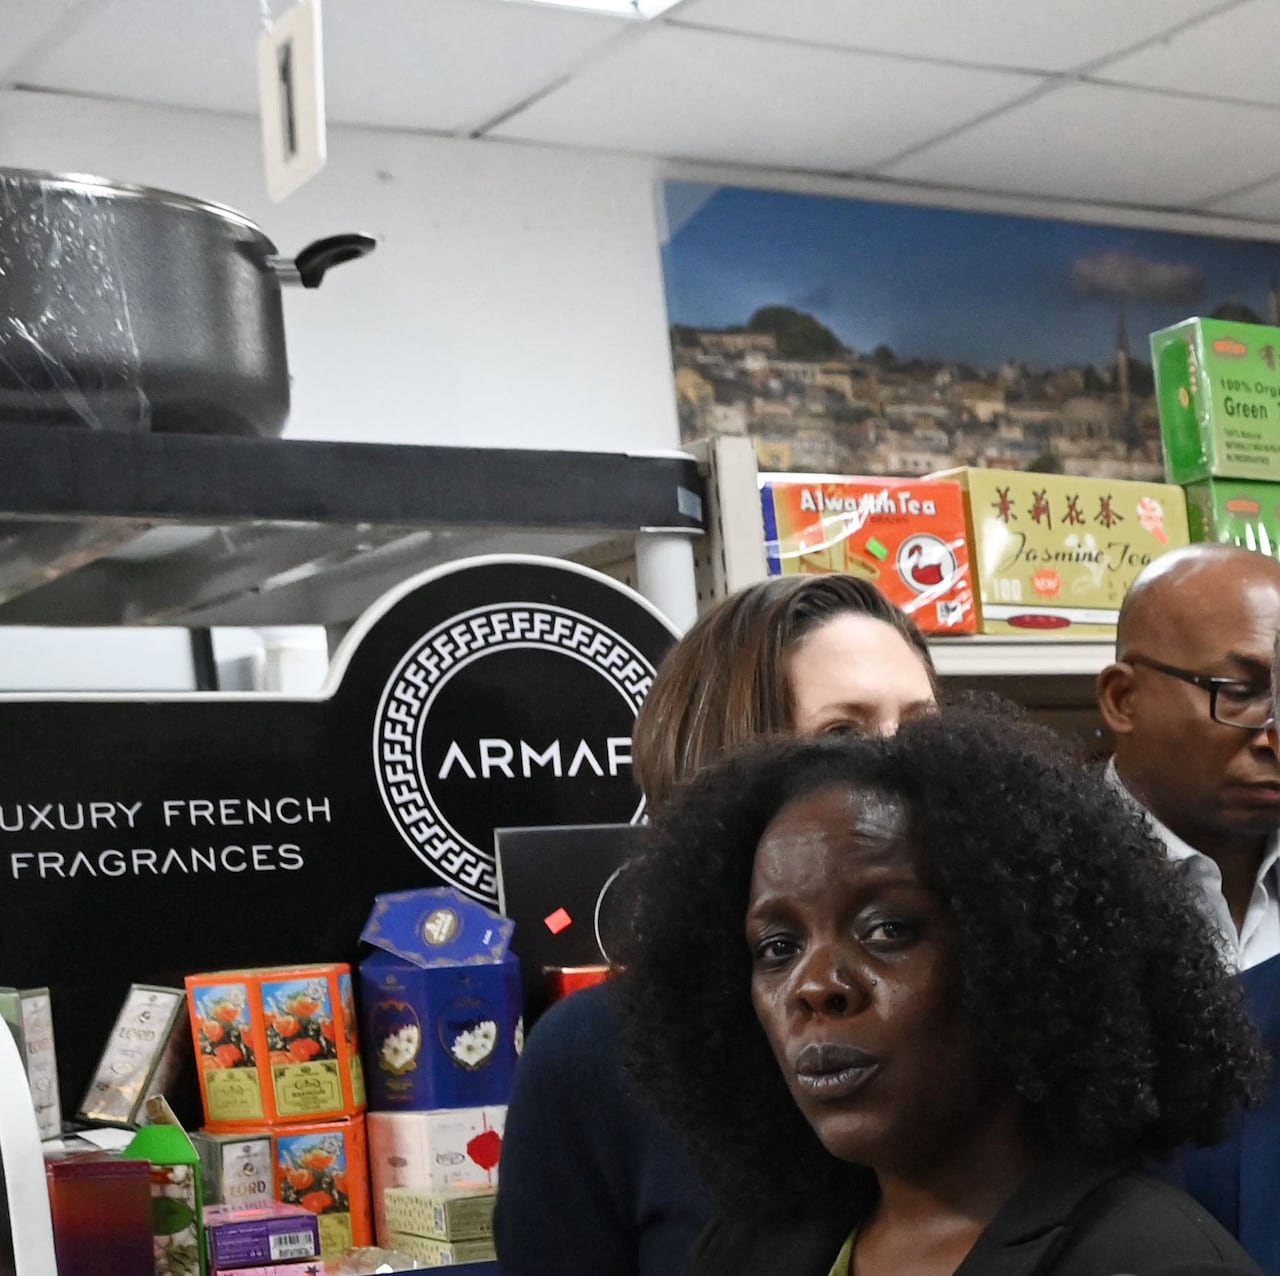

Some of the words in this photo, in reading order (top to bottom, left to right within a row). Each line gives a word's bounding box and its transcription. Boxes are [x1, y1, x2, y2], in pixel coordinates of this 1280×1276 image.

[1220, 378, 1252, 393] 100%
[1223, 397, 1268, 419] Green
[801, 489, 897, 515] Alwah
[897, 491, 937, 515] Tea
[991, 486, 1124, 530] 茉莉花茶
[998, 531, 1104, 572] Jasmine
[1106, 542, 1152, 572] Tea
[164, 796, 331, 828] FRENCH
[11, 844, 305, 880] FRAGRANCES
